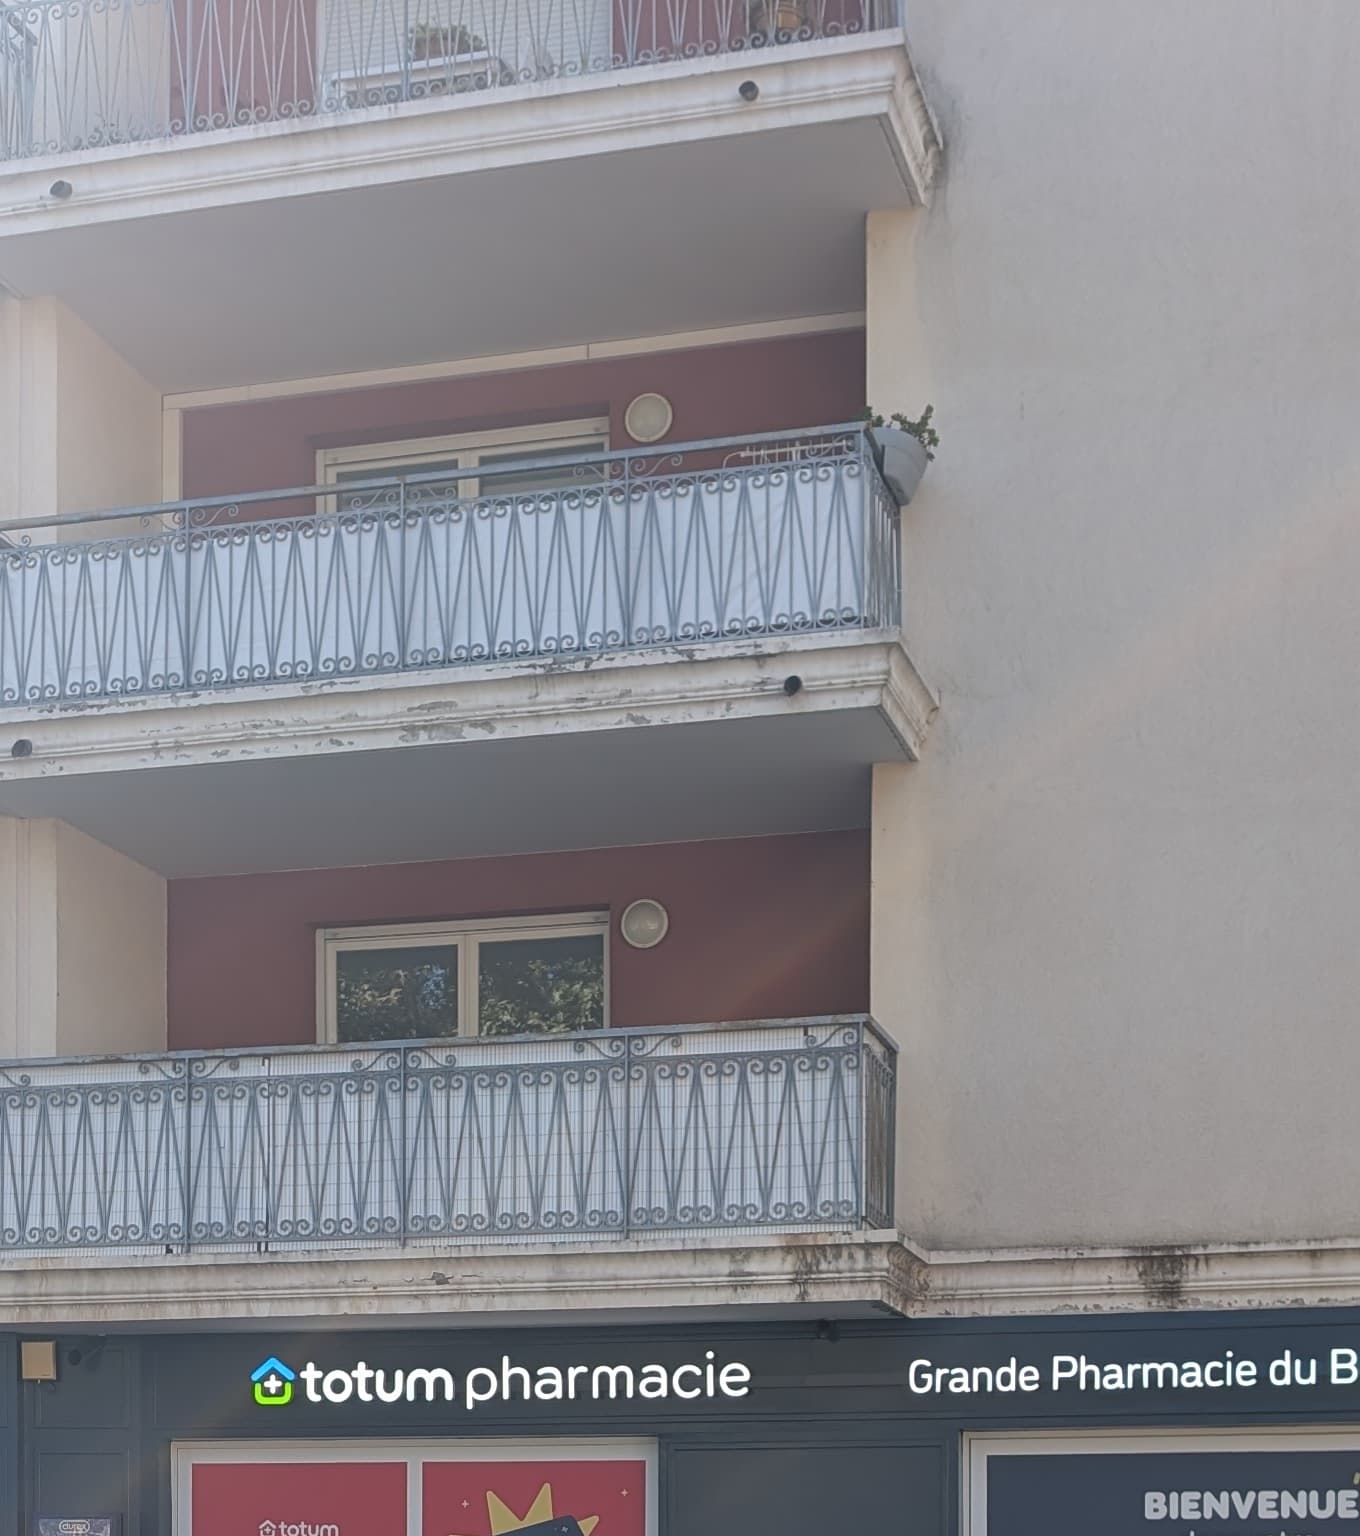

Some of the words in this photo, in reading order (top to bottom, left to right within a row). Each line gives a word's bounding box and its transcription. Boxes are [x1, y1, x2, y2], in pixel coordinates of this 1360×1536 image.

[300, 1361, 453, 1402] totum
[466, 1351, 751, 1409] pharmacie
[907, 1357, 1040, 1394] Grande
[1052, 1351, 1257, 1391] Pharmacie
[1269, 1349, 1317, 1386] du
[1143, 1490, 1359, 1520] BIENVENUE
[62, 1521, 86, 1530] durex
